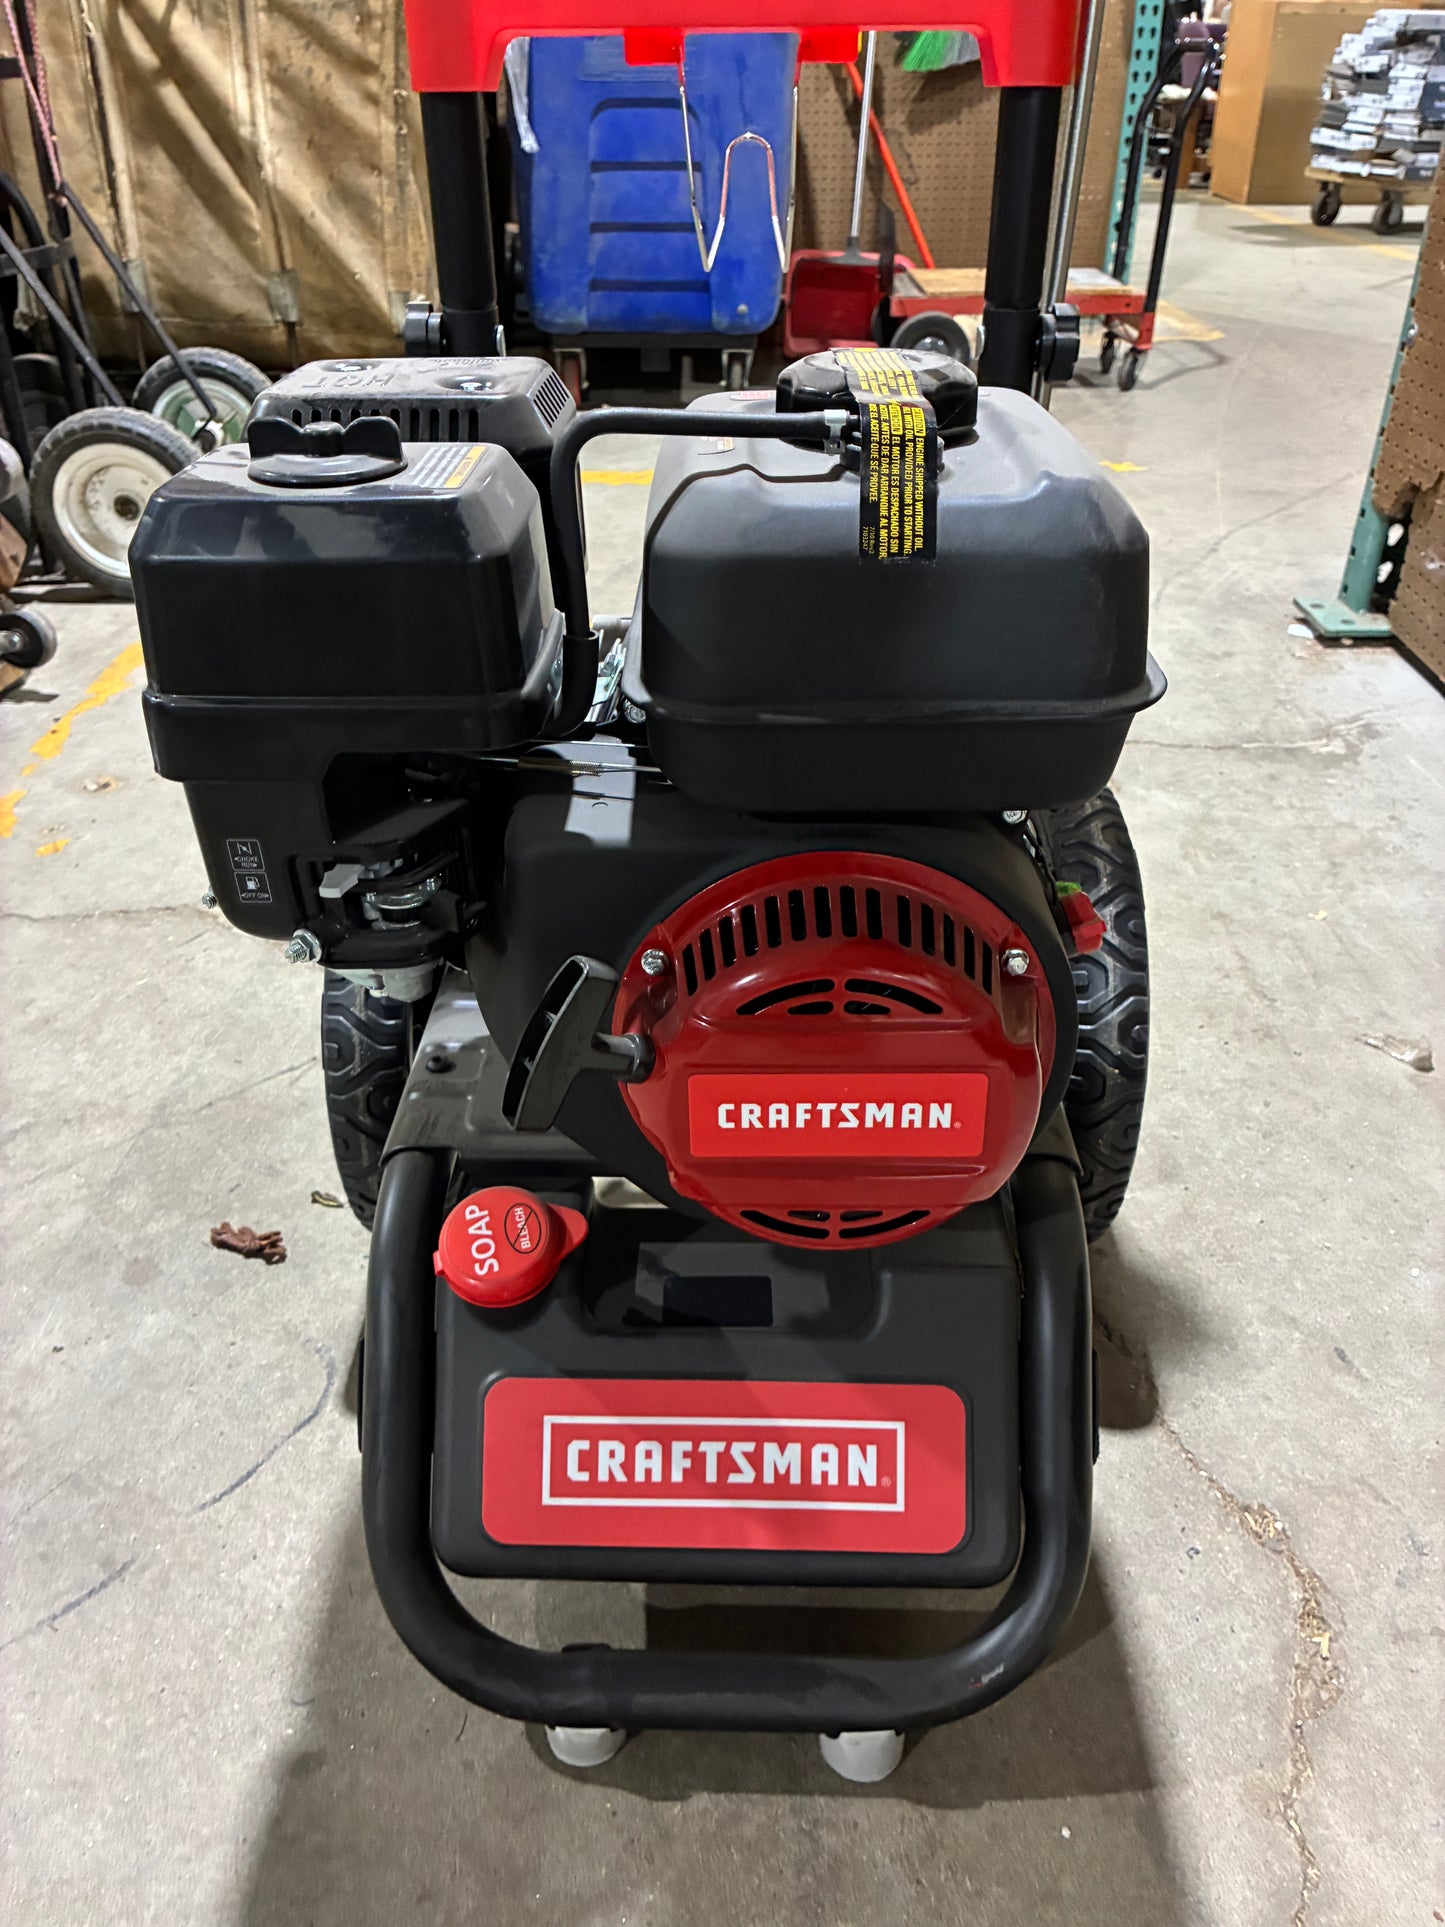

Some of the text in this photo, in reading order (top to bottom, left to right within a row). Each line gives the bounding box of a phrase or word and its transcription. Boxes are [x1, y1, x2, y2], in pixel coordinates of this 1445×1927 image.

[870, 419, 879, 442] ACEITE
[881, 421, 889, 444] ANTES
[904, 414, 913, 429] WITH
[892, 436, 900, 445] EL
[905, 430, 914, 441] OIL
[870, 443, 879, 459] QUE
[881, 446, 889, 456] DE
[891, 446, 900, 475] MOTOR
[904, 442, 913, 480] PROVIDED
[916, 438, 924, 466] ENGINE
[870, 460, 878, 471] SE
[880, 457, 889, 474] DAR
[891, 476, 900, 486] ES
[904, 481, 913, 504] PRIOR
[915, 467, 924, 500] SHIPPED
[879, 475, 889, 517] ARRANQUE
[890, 487, 899, 537] DESPACHADO
[904, 505, 912, 515] TO
[915, 501, 923, 536] WITHOUT
[879, 517, 888, 528] AL
[890, 538, 899, 553] SIN
[903, 516, 912, 556] STARTING.
[717, 1102, 953, 1129] CRAFTSMAN
[514, 1207, 532, 1249] BLEACH
[464, 1204, 500, 1276] SOAP
[566, 1439, 878, 1487] CRAFTSMAN
